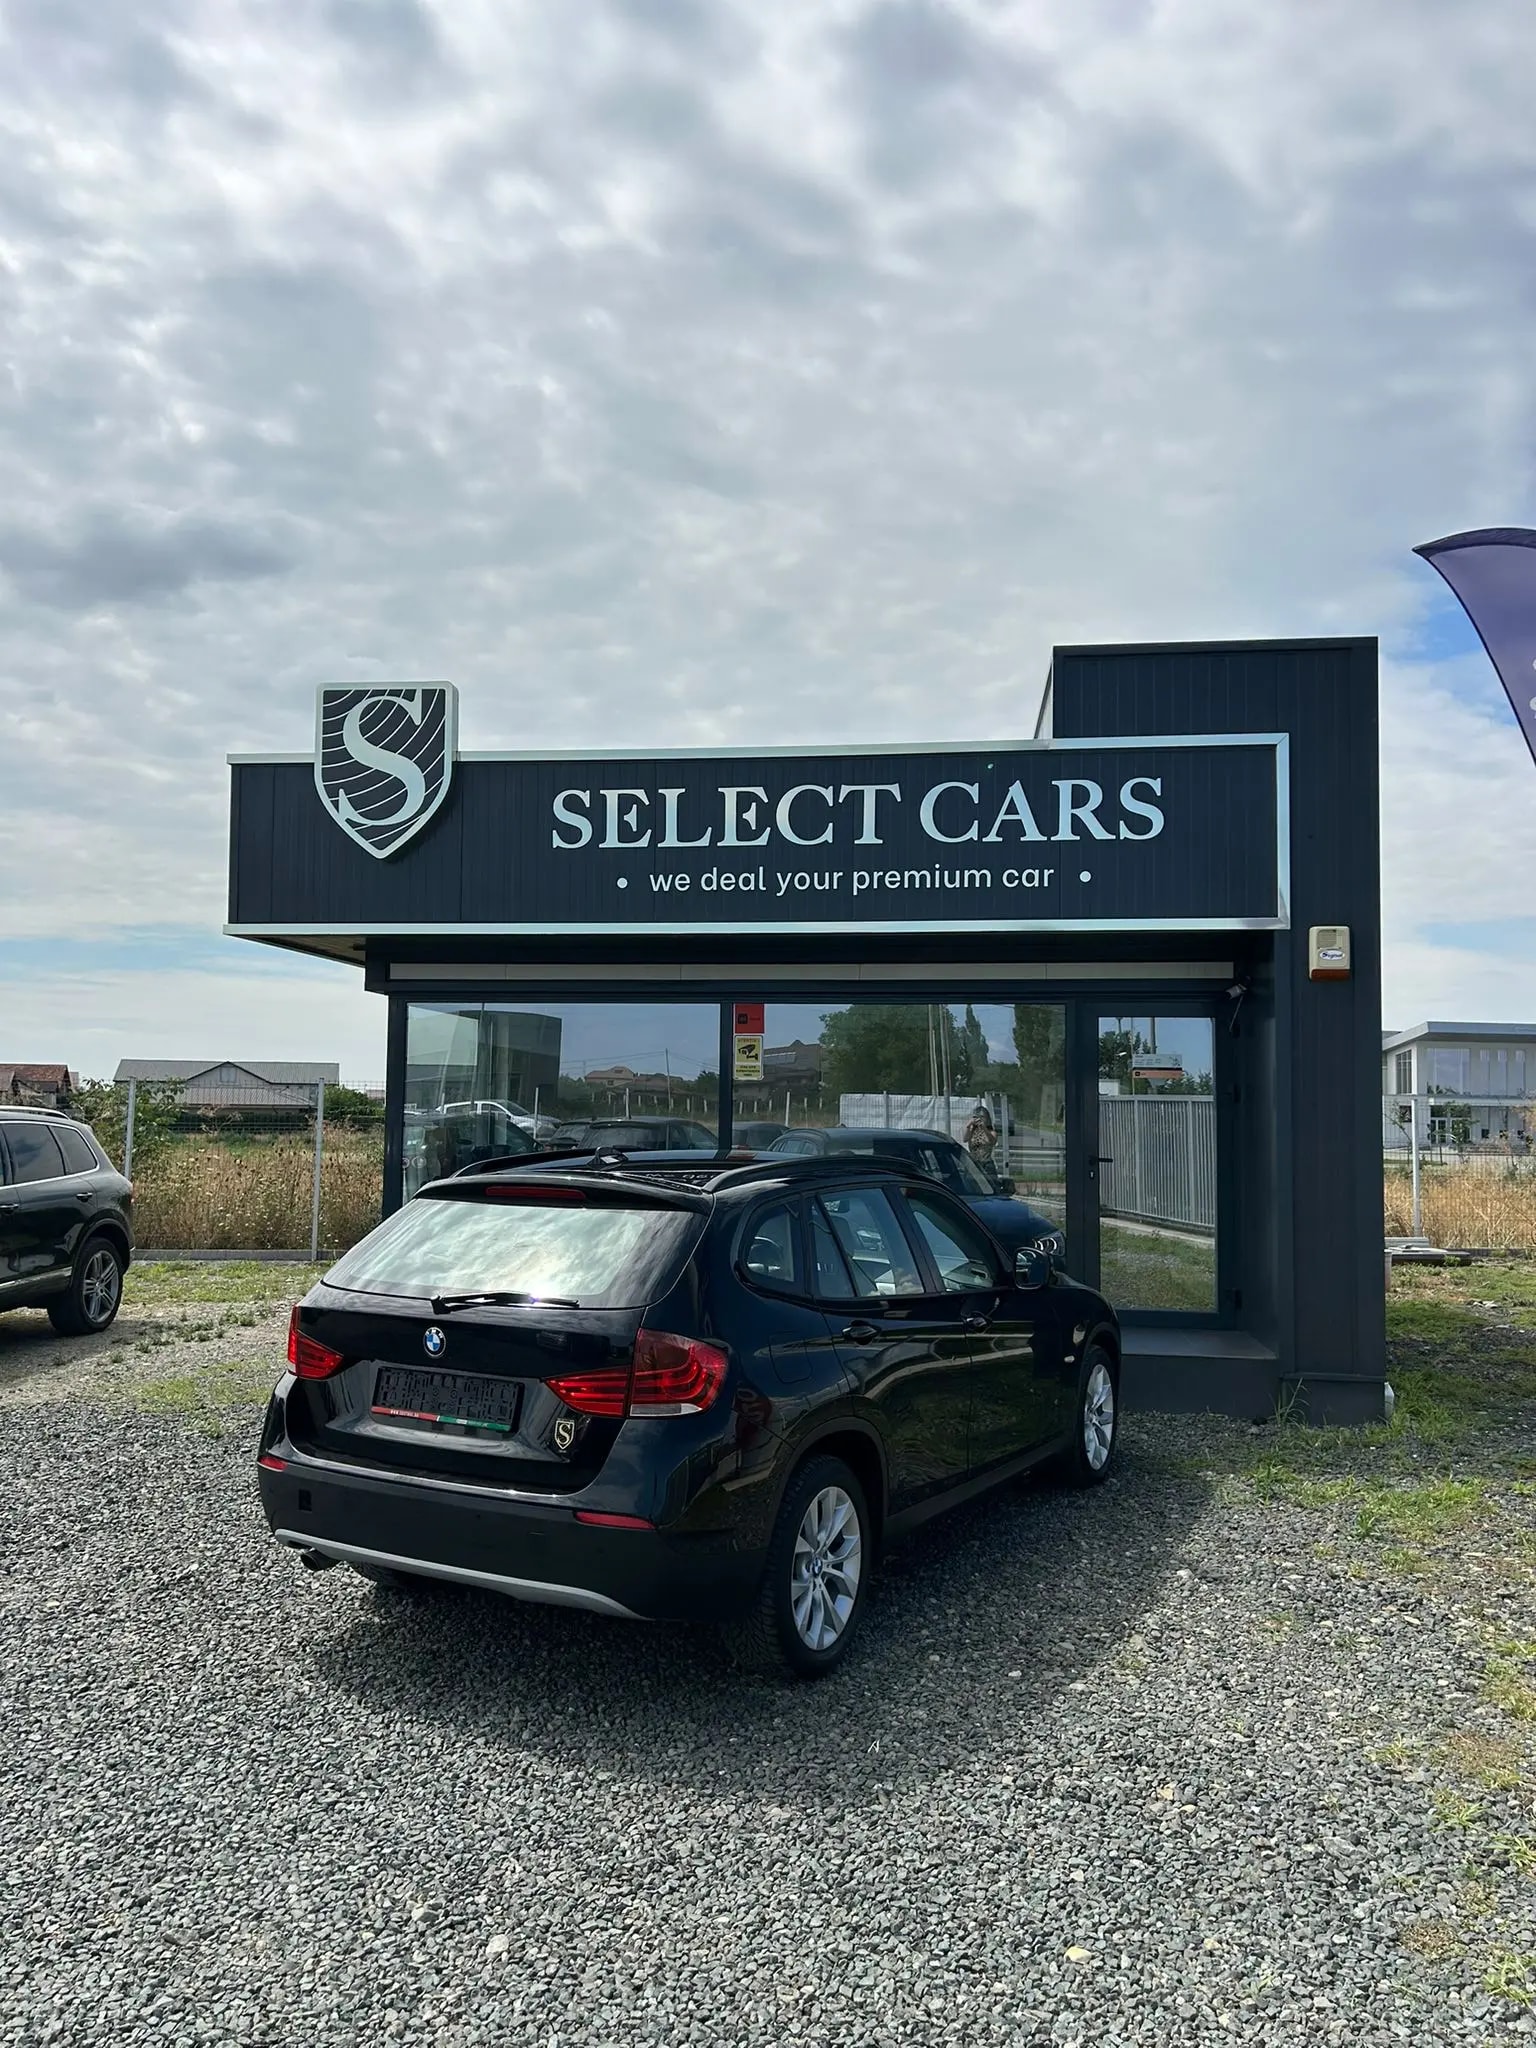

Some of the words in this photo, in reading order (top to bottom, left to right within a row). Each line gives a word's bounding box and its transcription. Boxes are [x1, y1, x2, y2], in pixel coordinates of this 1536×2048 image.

[343, 688, 425, 826] S
[552, 783, 902, 849] SELECT
[919, 777, 1165, 845] CARS
[650, 873, 691, 892] we
[700, 867, 767, 891] deal
[776, 870, 844, 897] your
[852, 863, 992, 896] premium
[1002, 868, 1055, 889] car
